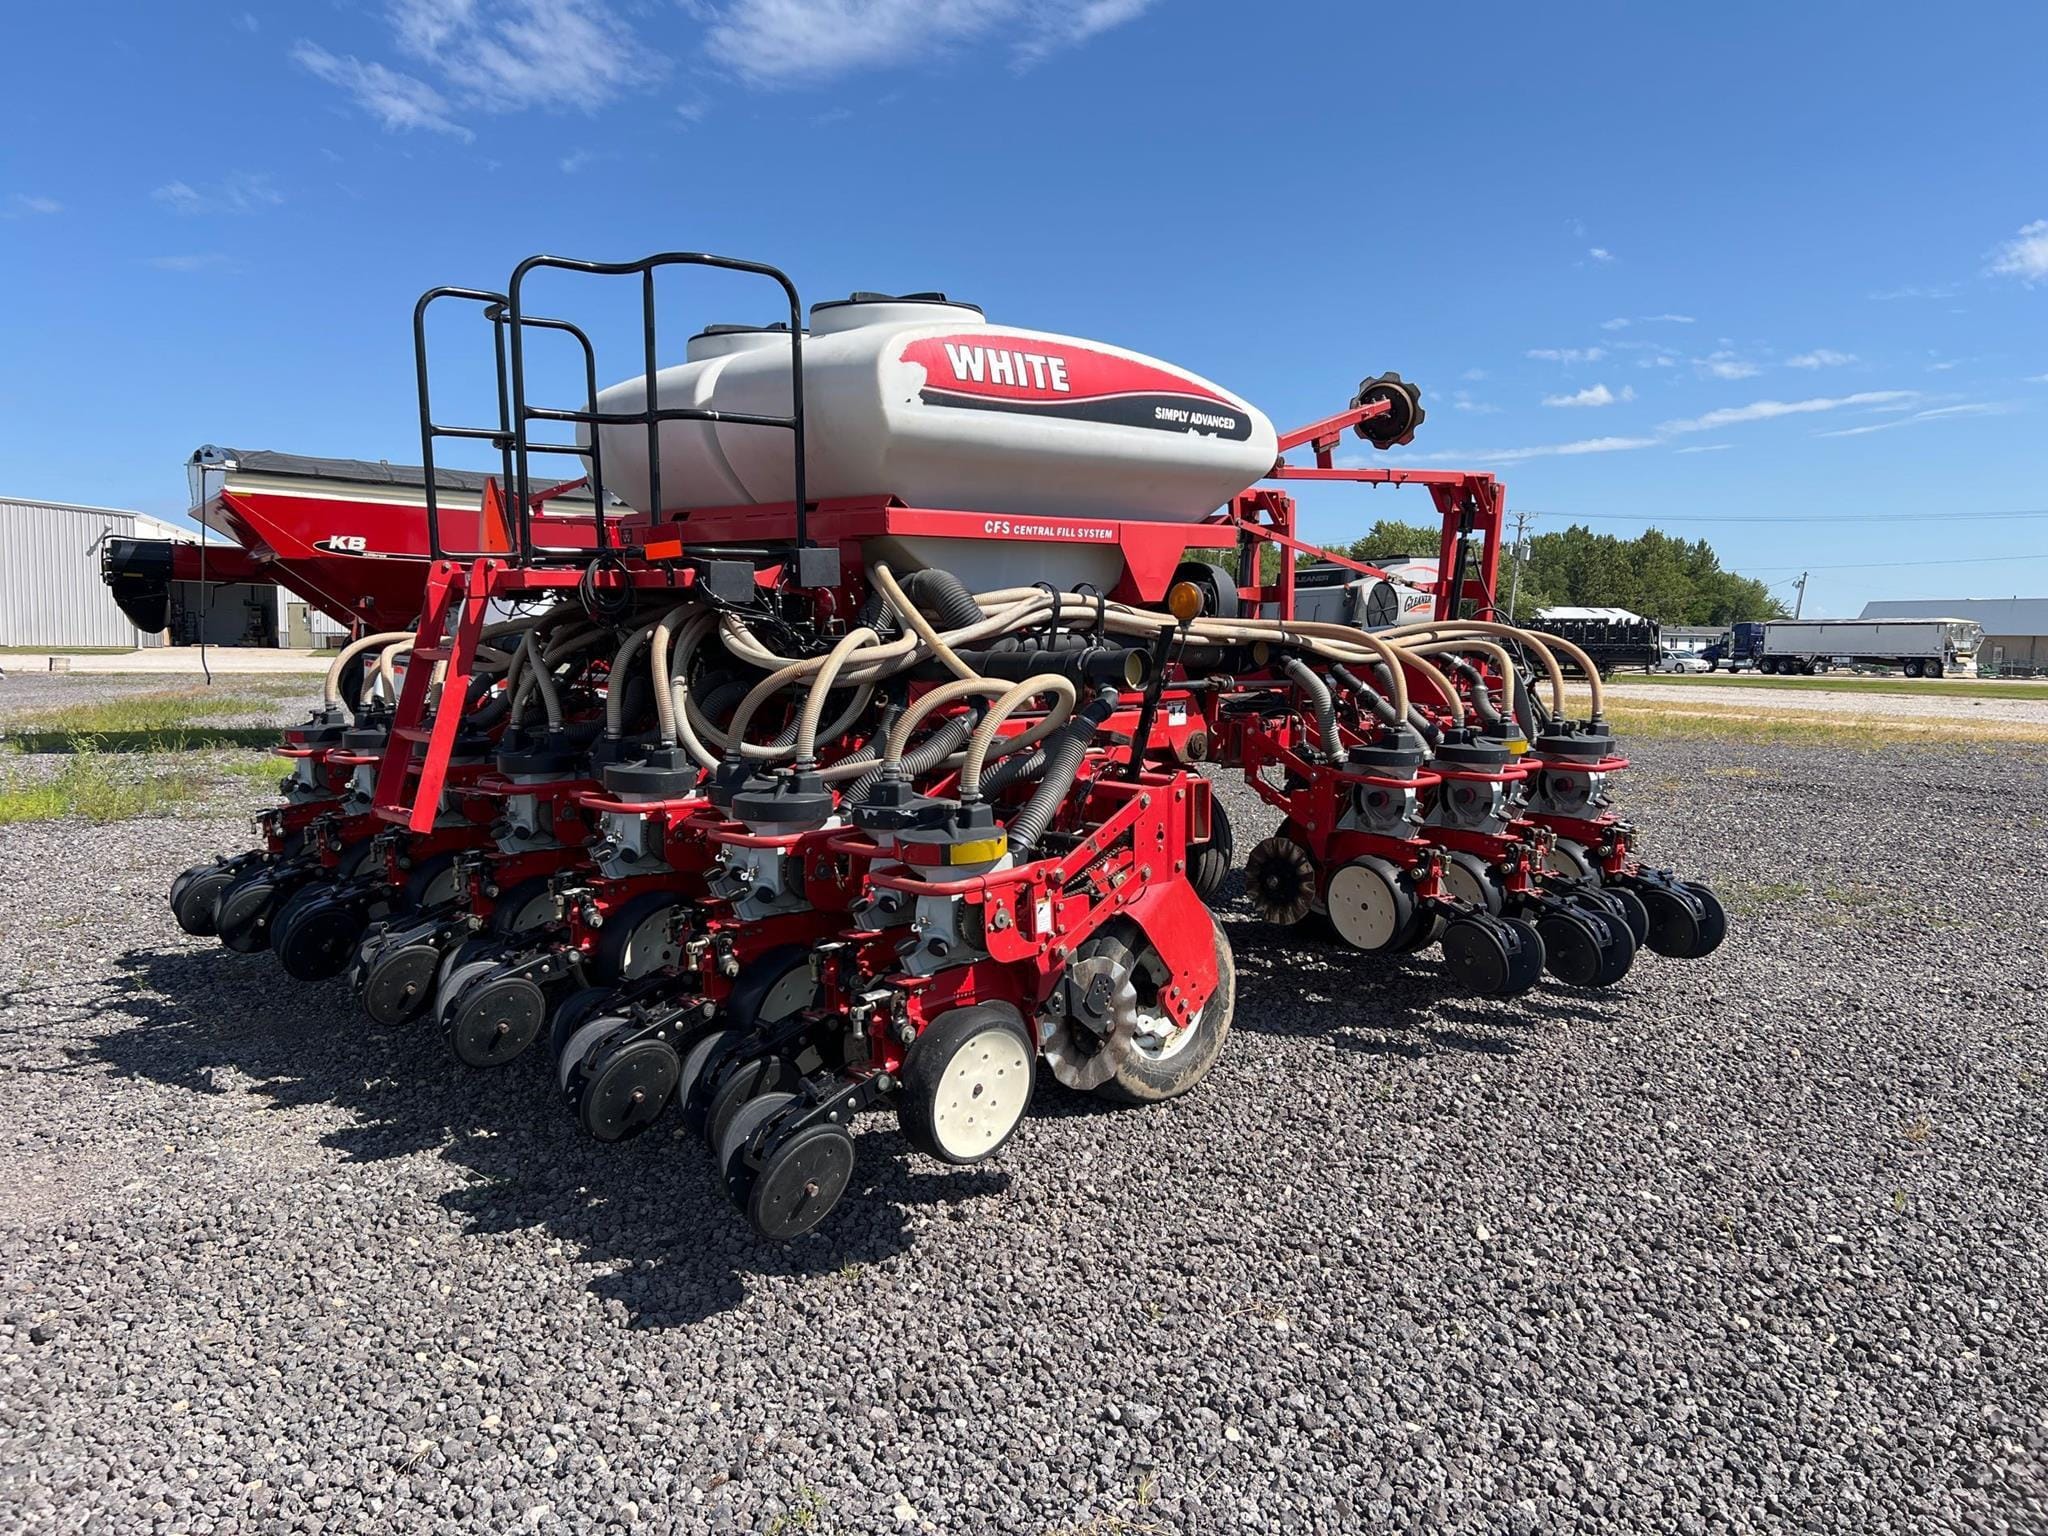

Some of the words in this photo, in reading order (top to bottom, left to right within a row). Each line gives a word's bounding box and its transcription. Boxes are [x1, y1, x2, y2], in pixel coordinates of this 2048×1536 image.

[944, 343, 1070, 393] WHITE
[1155, 408, 1189, 422] SIMPLY
[1190, 413, 1235, 429] ADVANCED
[984, 520, 1010, 534] CFS
[1013, 525, 1055, 537] CENTRAL
[1056, 527, 1076, 538] FILL
[1077, 528, 1113, 539] SYSTEM
[329, 535, 366, 550] KB
[1296, 575, 1328, 583] LEANER
[1404, 595, 1433, 612] GLEANER
